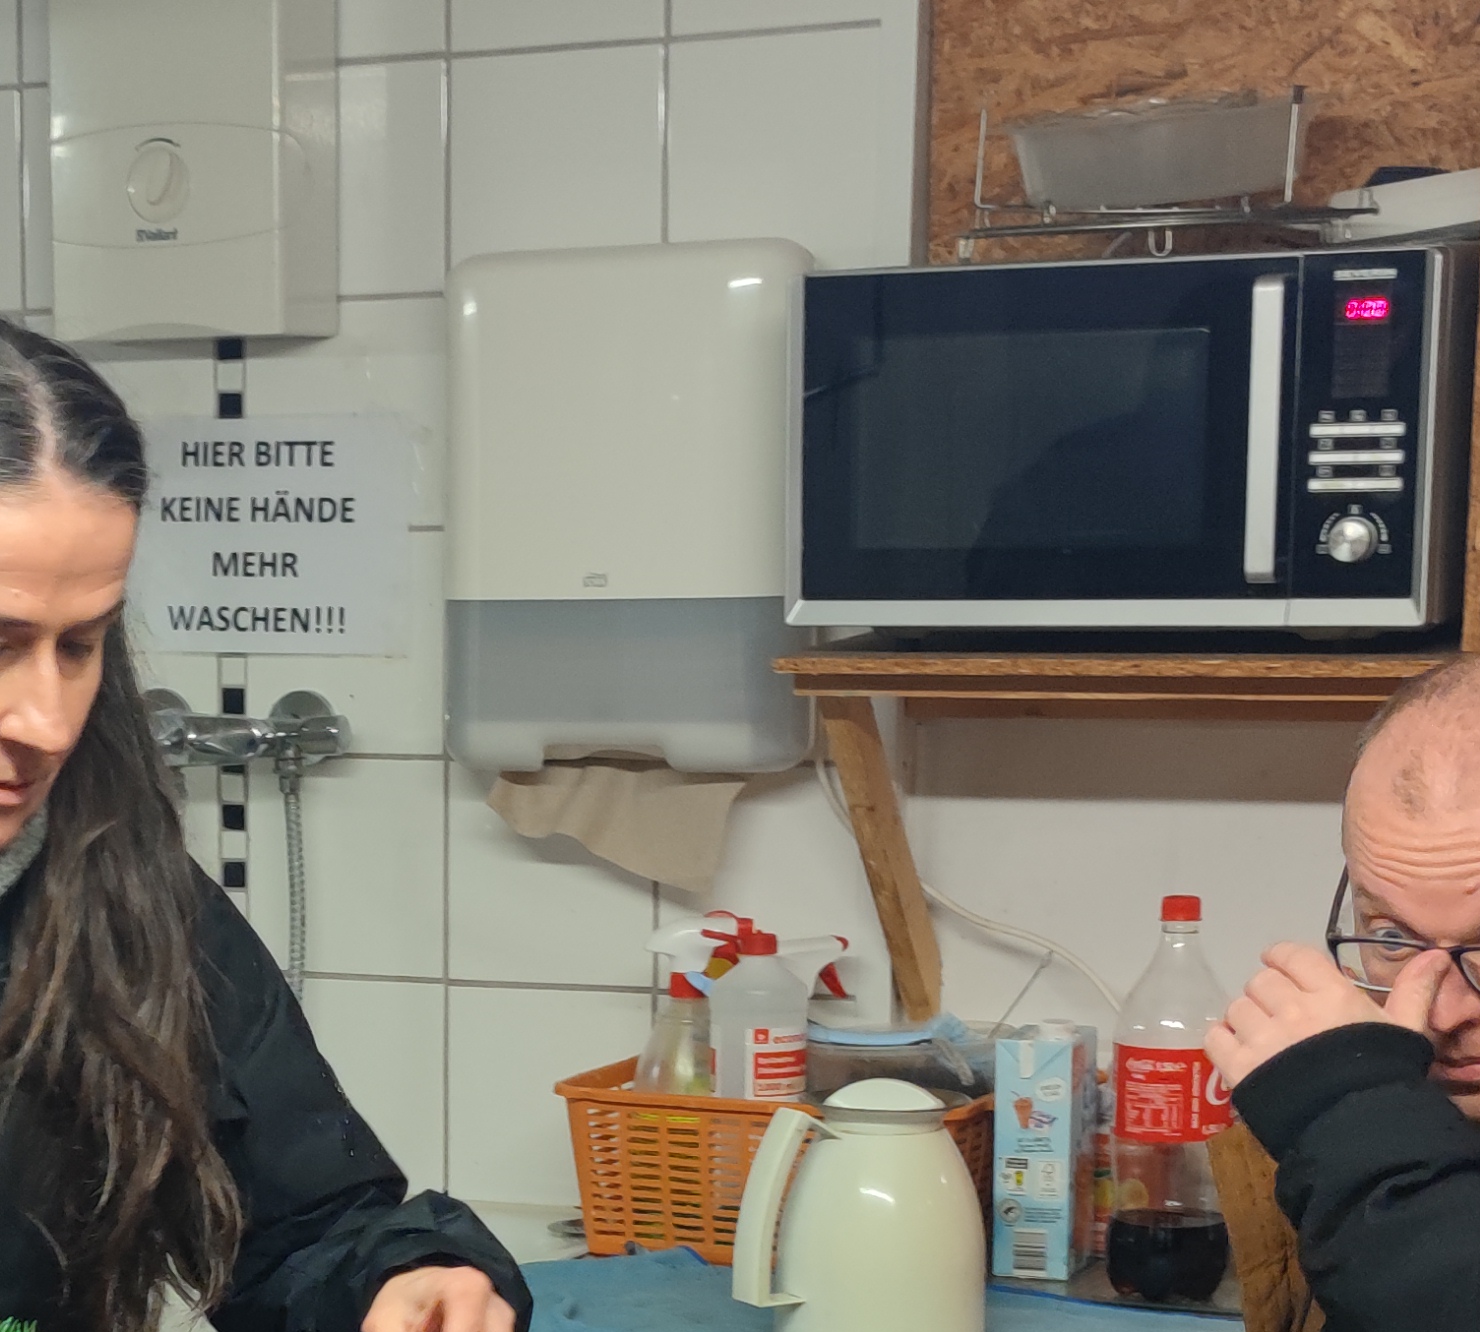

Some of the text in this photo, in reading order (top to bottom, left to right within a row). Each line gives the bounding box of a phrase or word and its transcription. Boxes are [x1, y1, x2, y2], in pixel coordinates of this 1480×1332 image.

[181, 441, 335, 467] HIER BITTE
[160, 490, 356, 523] KEINE HÄNDE
[212, 552, 299, 577] MEHR
[168, 606, 346, 633] WASCHEN!!!
